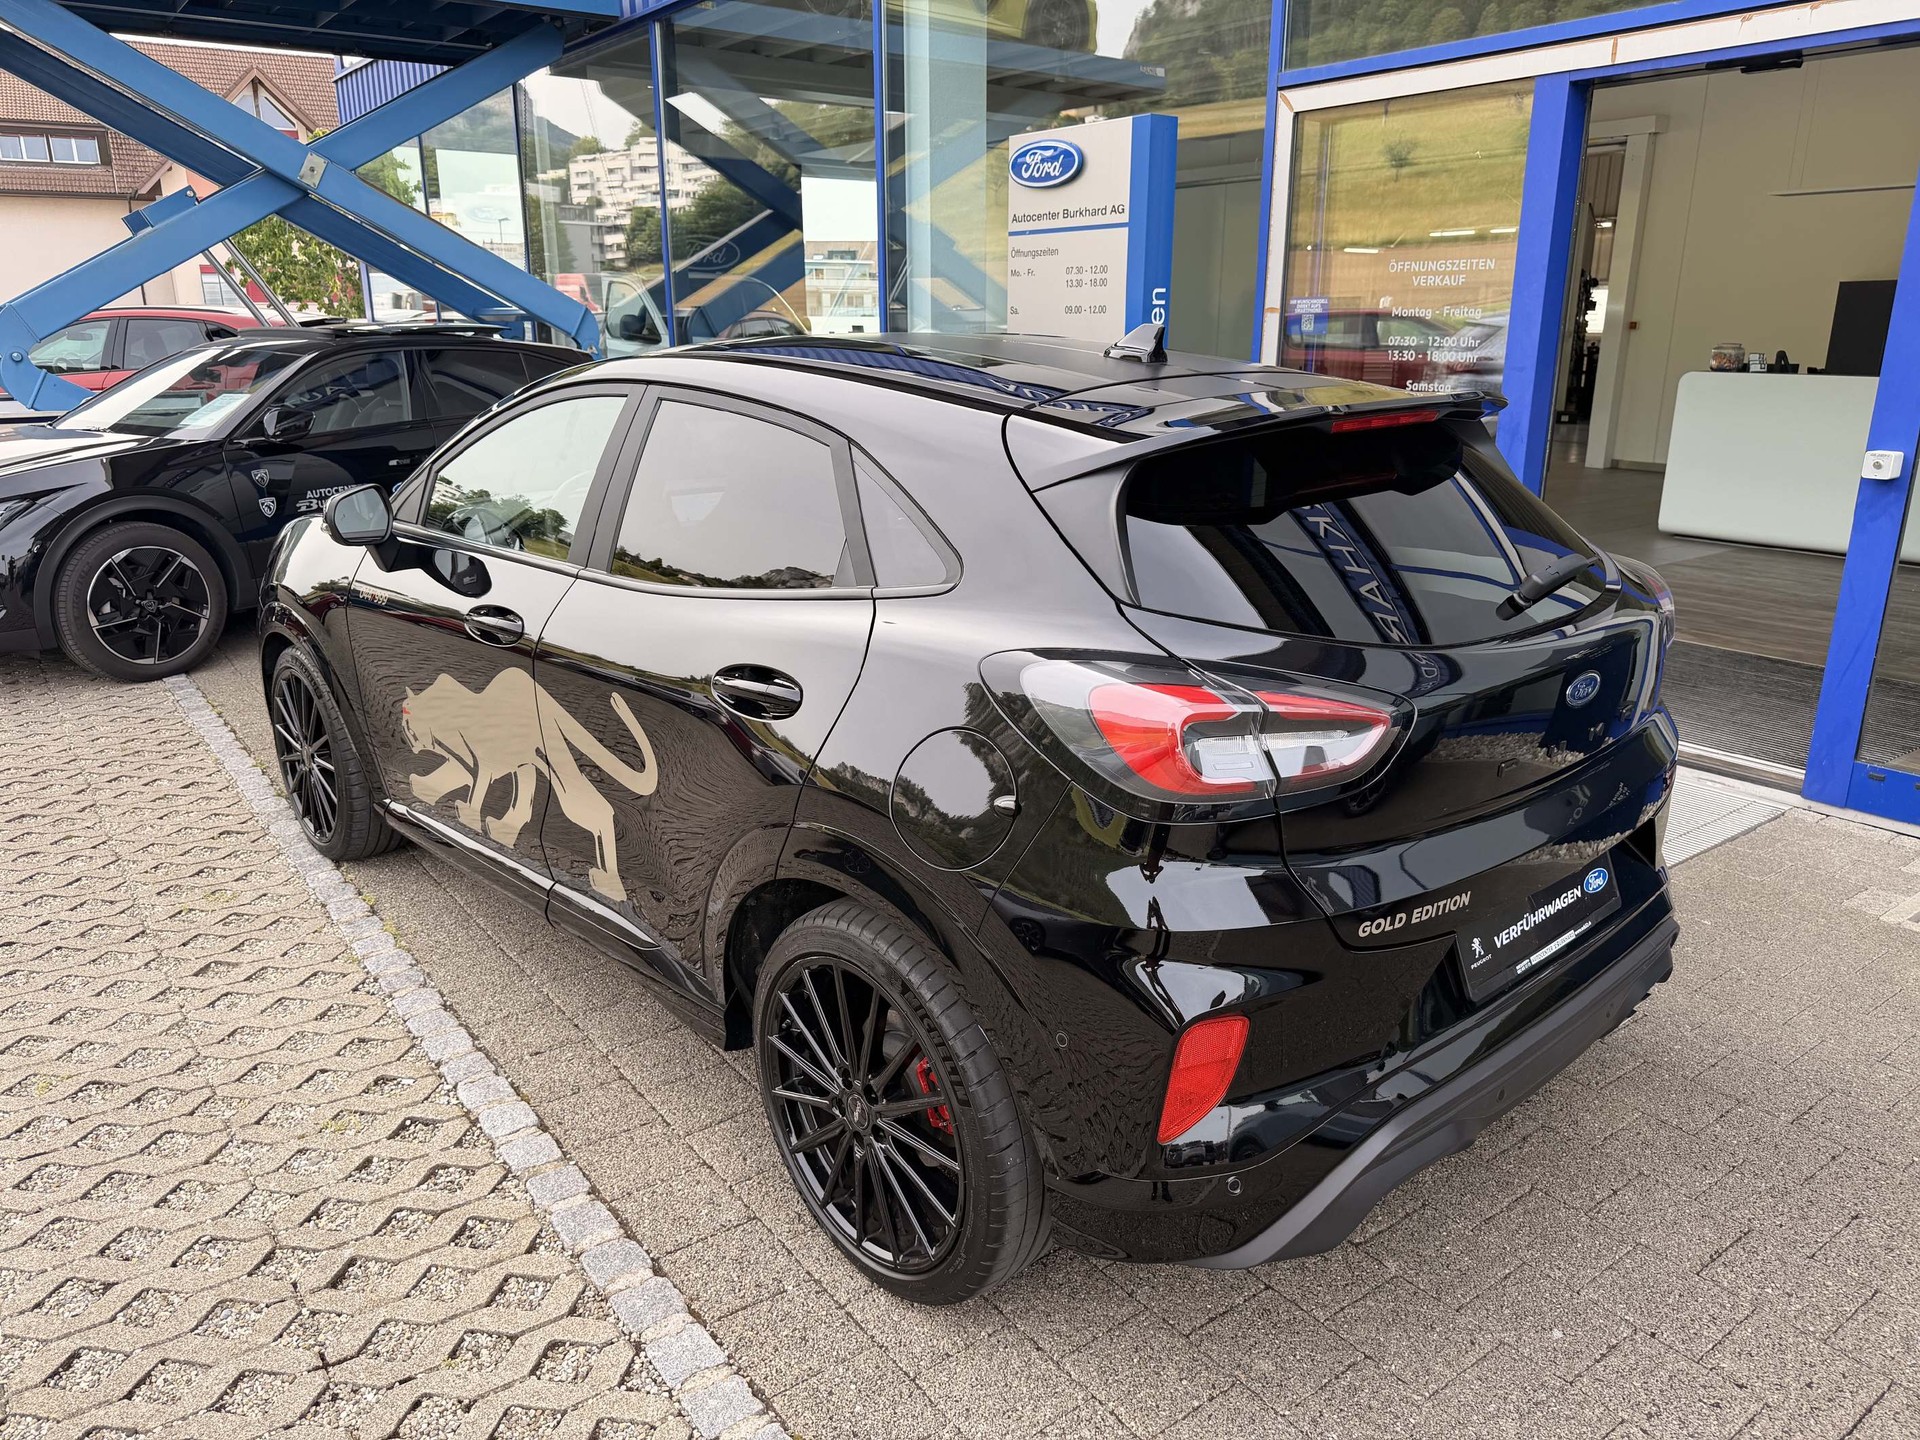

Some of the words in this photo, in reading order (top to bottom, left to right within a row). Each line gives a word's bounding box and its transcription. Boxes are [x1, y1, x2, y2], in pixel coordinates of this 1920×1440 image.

[1021, 149, 1063, 178] Ford
[1011, 210, 1060, 224] Autocenter
[1062, 205, 1107, 219] Burkhard
[1109, 204, 1125, 215] AG
[1010, 247, 1059, 260] Öffnungszeiten
[1065, 266, 1083, 275] 07.30
[1090, 265, 1109, 275] 12.00
[1388, 258, 1496, 273] ÖFFNUNGSZEITEN
[1010, 269, 1022, 278] Mo.
[1027, 268, 1036, 277] Fr.
[1065, 279, 1083, 288] 13.30
[1089, 278, 1108, 287] 18.00
[1412, 275, 1466, 287] VERKAUF
[1010, 306, 1020, 315] Sa.
[1064, 306, 1083, 315] 09.00
[1089, 305, 1107, 315] 12.00
[1151, 287, 1167, 325] en
[1391, 306, 1432, 319] Montag
[1443, 305, 1482, 319] Freitag
[1388, 337, 1417, 347] 07:30
[1428, 337, 1457, 347] 12:00
[1459, 336, 1481, 348] Uhr
[1387, 350, 1416, 361] 13:30
[1426, 351, 1455, 362] 18:00
[1458, 352, 1479, 363] Uhr
[1358, 912, 1407, 938] GOLD
[1411, 891, 1472, 925] EDITION
[1493, 885, 1582, 949] VERFÜHRWAGEN
[1470, 953, 1492, 970] PEUGEOT
[904, 990, 969, 1099] MICHELIN
